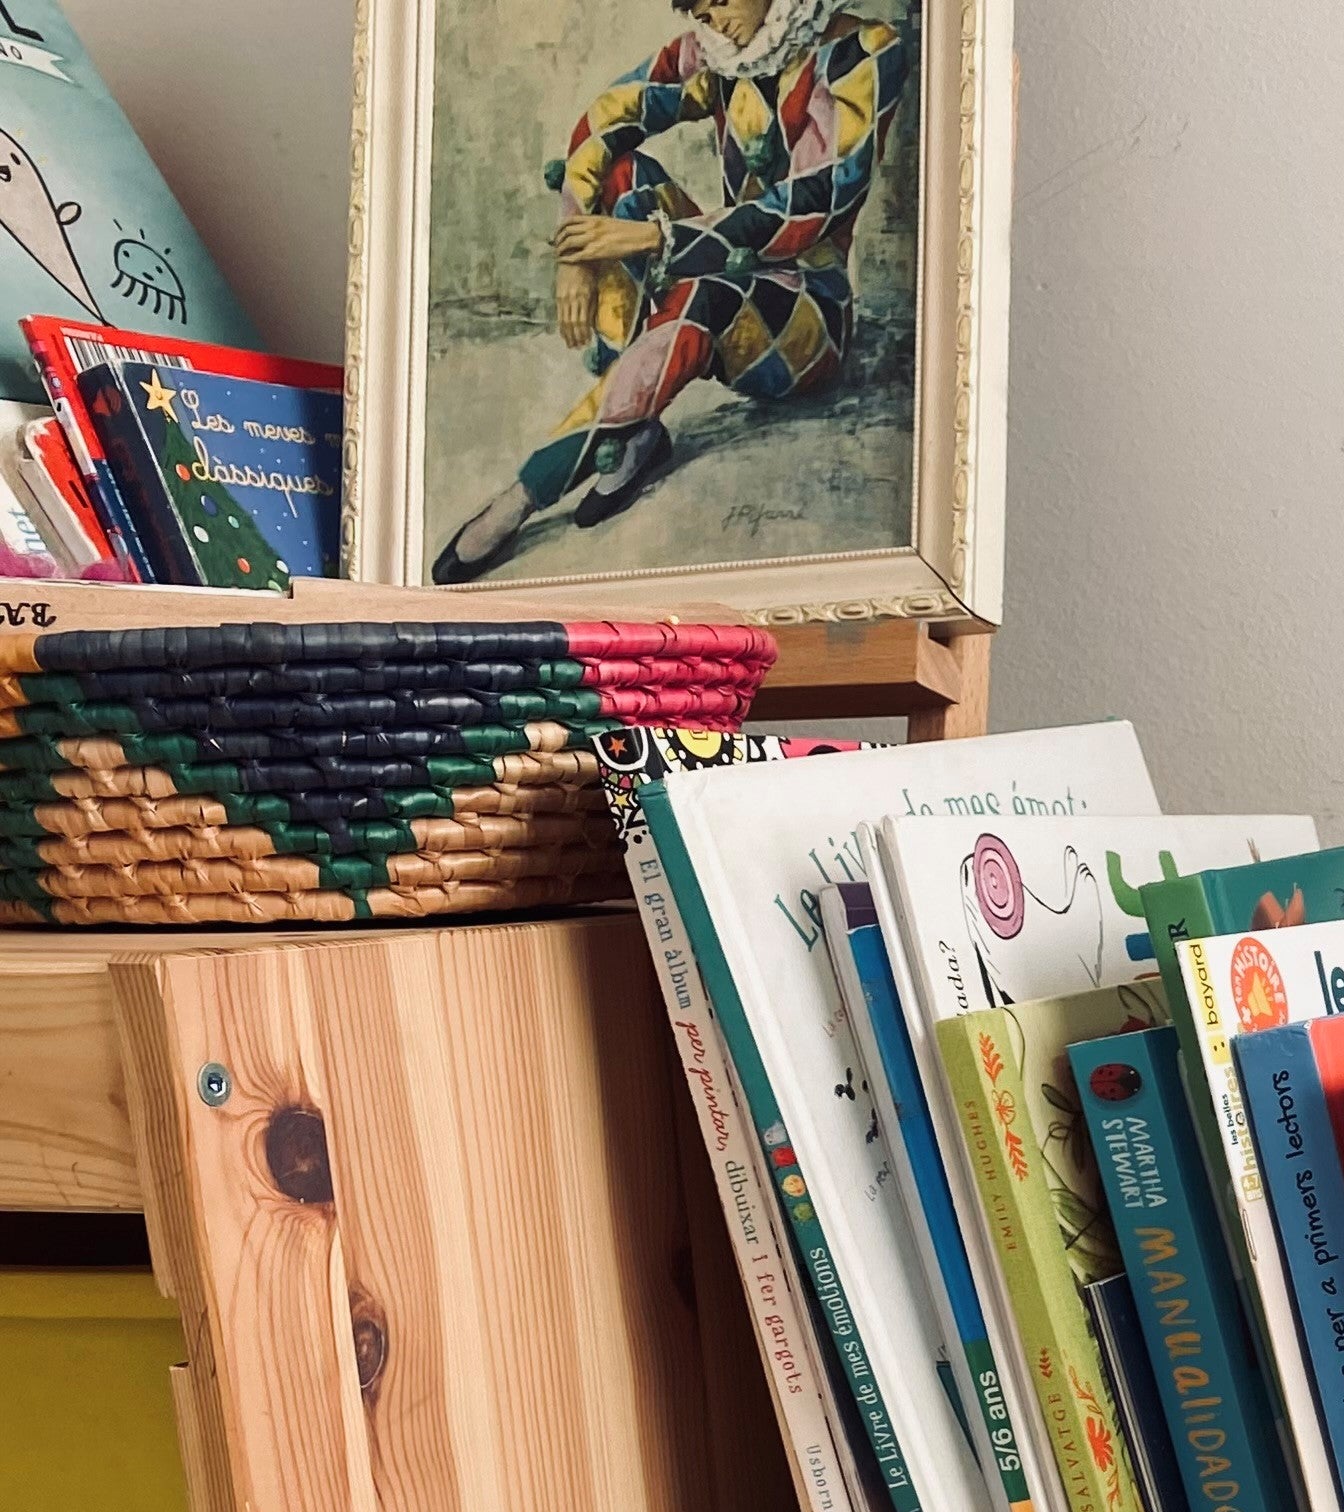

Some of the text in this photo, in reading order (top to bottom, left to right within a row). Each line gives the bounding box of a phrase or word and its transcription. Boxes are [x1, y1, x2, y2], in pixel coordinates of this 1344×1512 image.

[180, 388, 235, 434] Les
[243, 419, 316, 445] meves
[0, 602, 57, 627] BA
[638, 858, 662, 884] El
[644, 892, 674, 944] gran
[938, 940, 969, 1017] ada?
[1189, 944, 1220, 1026] bayard
[675, 1020, 706, 1064] per
[1222, 1093, 1240, 1146] les belles
[1272, 1069, 1305, 1160] lectors
[725, 1160, 760, 1245] dibuixar
[963, 1100, 1019, 1251] EMILY HUGHES
[1101, 1117, 1146, 1210] STEWART
[1125, 1115, 1169, 1210] MARTHA
[1296, 1168, 1340, 1266] primers
[756, 1272, 778, 1307] fer
[1320, 1276, 1338, 1296] a
[764, 1314, 803, 1395] gargots
[809, 1247, 909, 1490] Le Livre de mes émotions
[979, 1369, 1021, 1472] 5/6 ans
